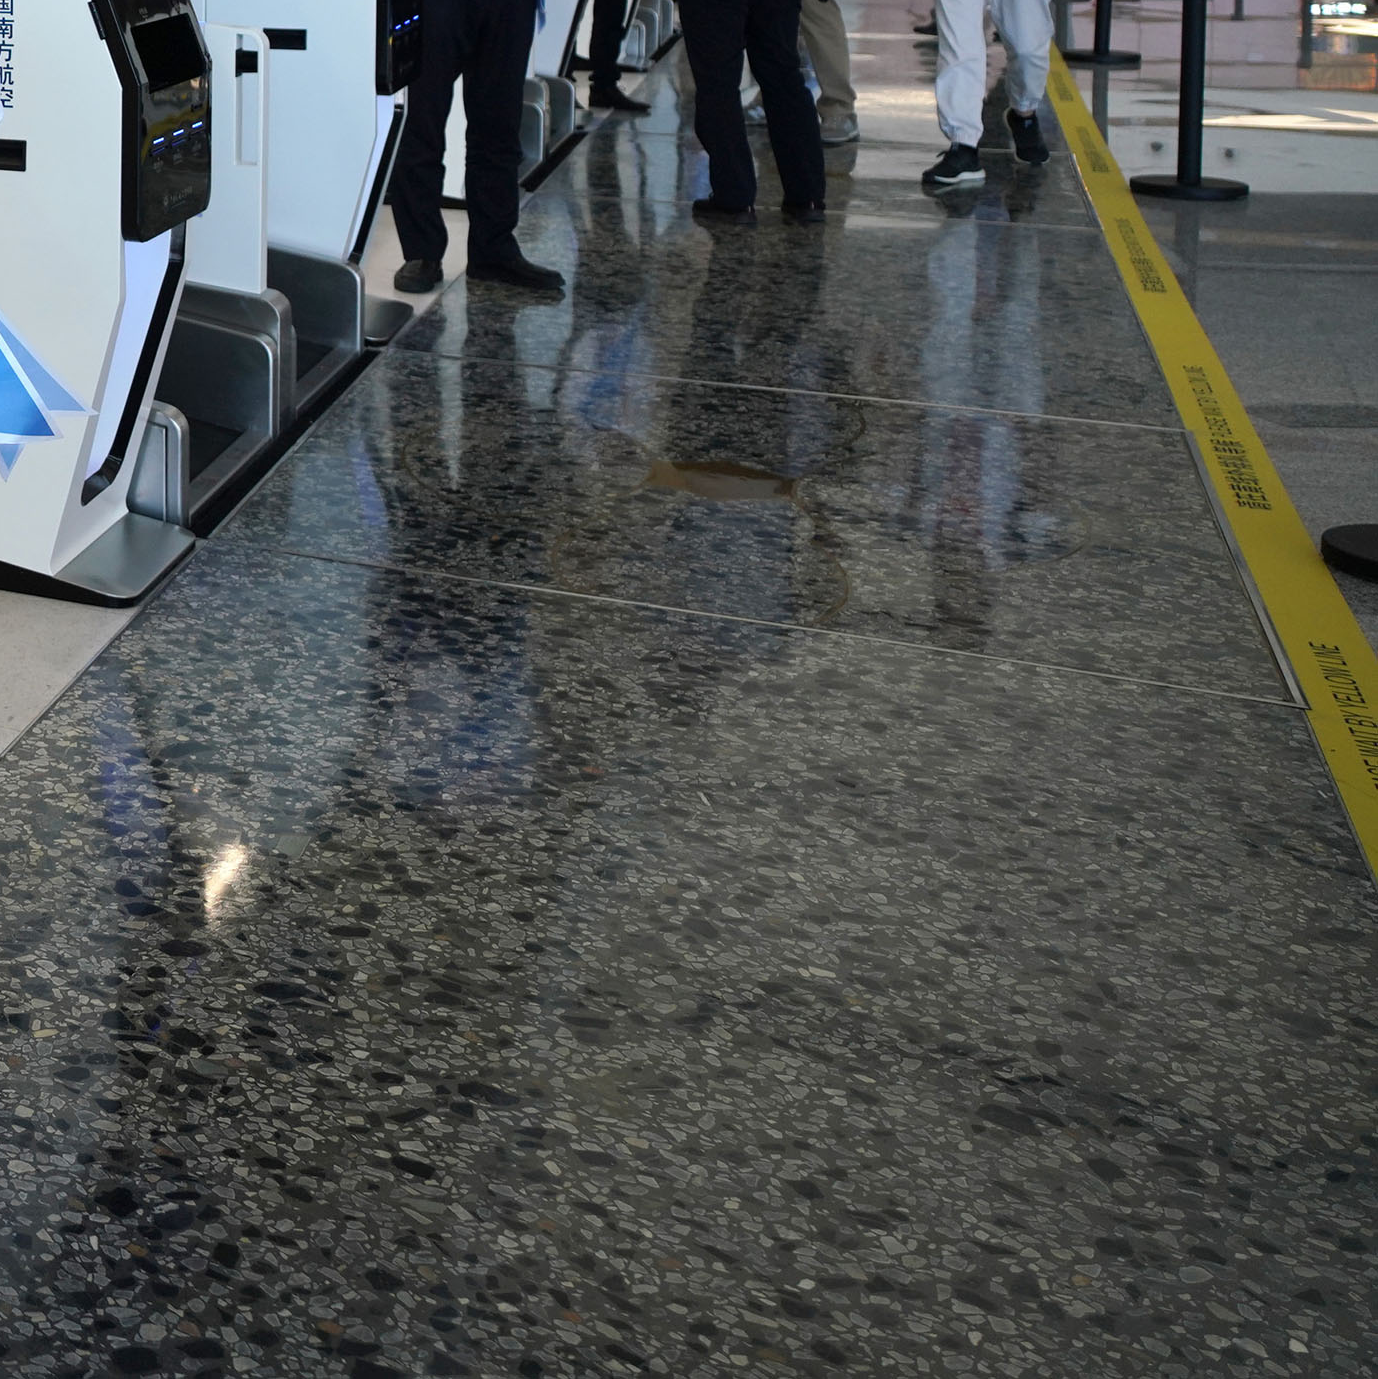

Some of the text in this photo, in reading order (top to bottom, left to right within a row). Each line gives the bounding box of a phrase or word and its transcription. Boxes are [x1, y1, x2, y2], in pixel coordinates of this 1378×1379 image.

[1308, 640, 1348, 667] LINE
[1319, 664, 1369, 710] YELLOW
[1340, 708, 1378, 729] BY
